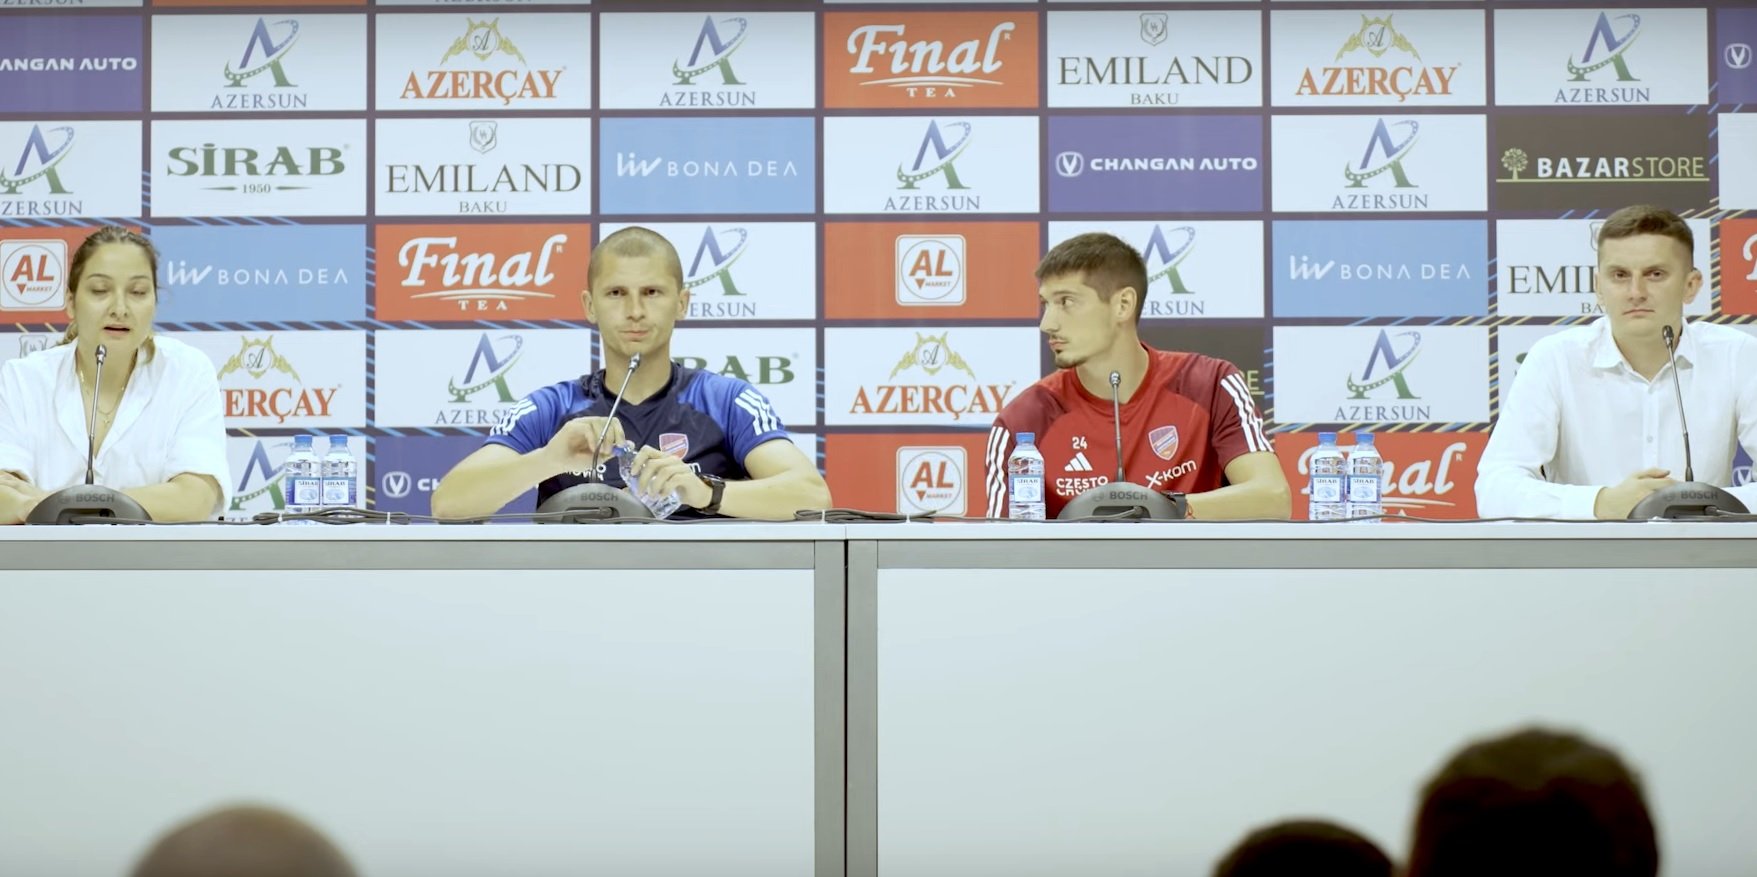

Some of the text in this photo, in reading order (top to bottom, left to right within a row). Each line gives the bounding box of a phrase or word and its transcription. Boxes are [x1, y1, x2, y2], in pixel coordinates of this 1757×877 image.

[847, 22, 1015, 74] Final
[79, 58, 137, 71] AUTO
[1057, 56, 1253, 85] EMILAND
[400, 70, 562, 105] AZERÇAY
[1296, 66, 1456, 102] AZERÇAY
[659, 91, 756, 107] AZERSUN
[907, 88, 956, 98] TEA
[1130, 92, 1180, 105] BAKU
[1554, 88, 1651, 103] AZERSUN
[211, 94, 308, 109] AZERSUN
[667, 161, 738, 177] BONA
[748, 161, 799, 177] DEA
[1090, 157, 1258, 171] CHANGAN AUTO
[385, 164, 582, 193] EMILAND
[242, 184, 272, 194] 1950
[1, 200, 83, 215] ZERSUN
[459, 200, 508, 213] BAKU
[884, 195, 981, 211] AZERSUN
[1332, 193, 1429, 209] AZERSUN
[11, 254, 55, 282] AL
[399, 234, 568, 287] Final
[908, 249, 954, 277] AL
[217, 268, 289, 285] BONA
[298, 268, 349, 285] DEA
[1340, 263, 1411, 280] BONA
[1421, 263, 1471, 280] DEA
[457, 300, 508, 311] TEA
[690, 302, 757, 317] ERSUN
[1146, 301, 1205, 316] RSUN
[225, 388, 337, 423] ERÇAY
[849, 385, 1013, 421] AZERÇAY
[435, 410, 504, 425] AZERS
[1334, 405, 1431, 421] AZERSUN
[1072, 436, 1088, 450] 24
[911, 461, 955, 488] AL
[76, 493, 115, 503] BOSCH
[580, 492, 619, 501] BOSCH
[1109, 491, 1149, 501] BOSCH
[1680, 490, 1719, 500] BOSCH
